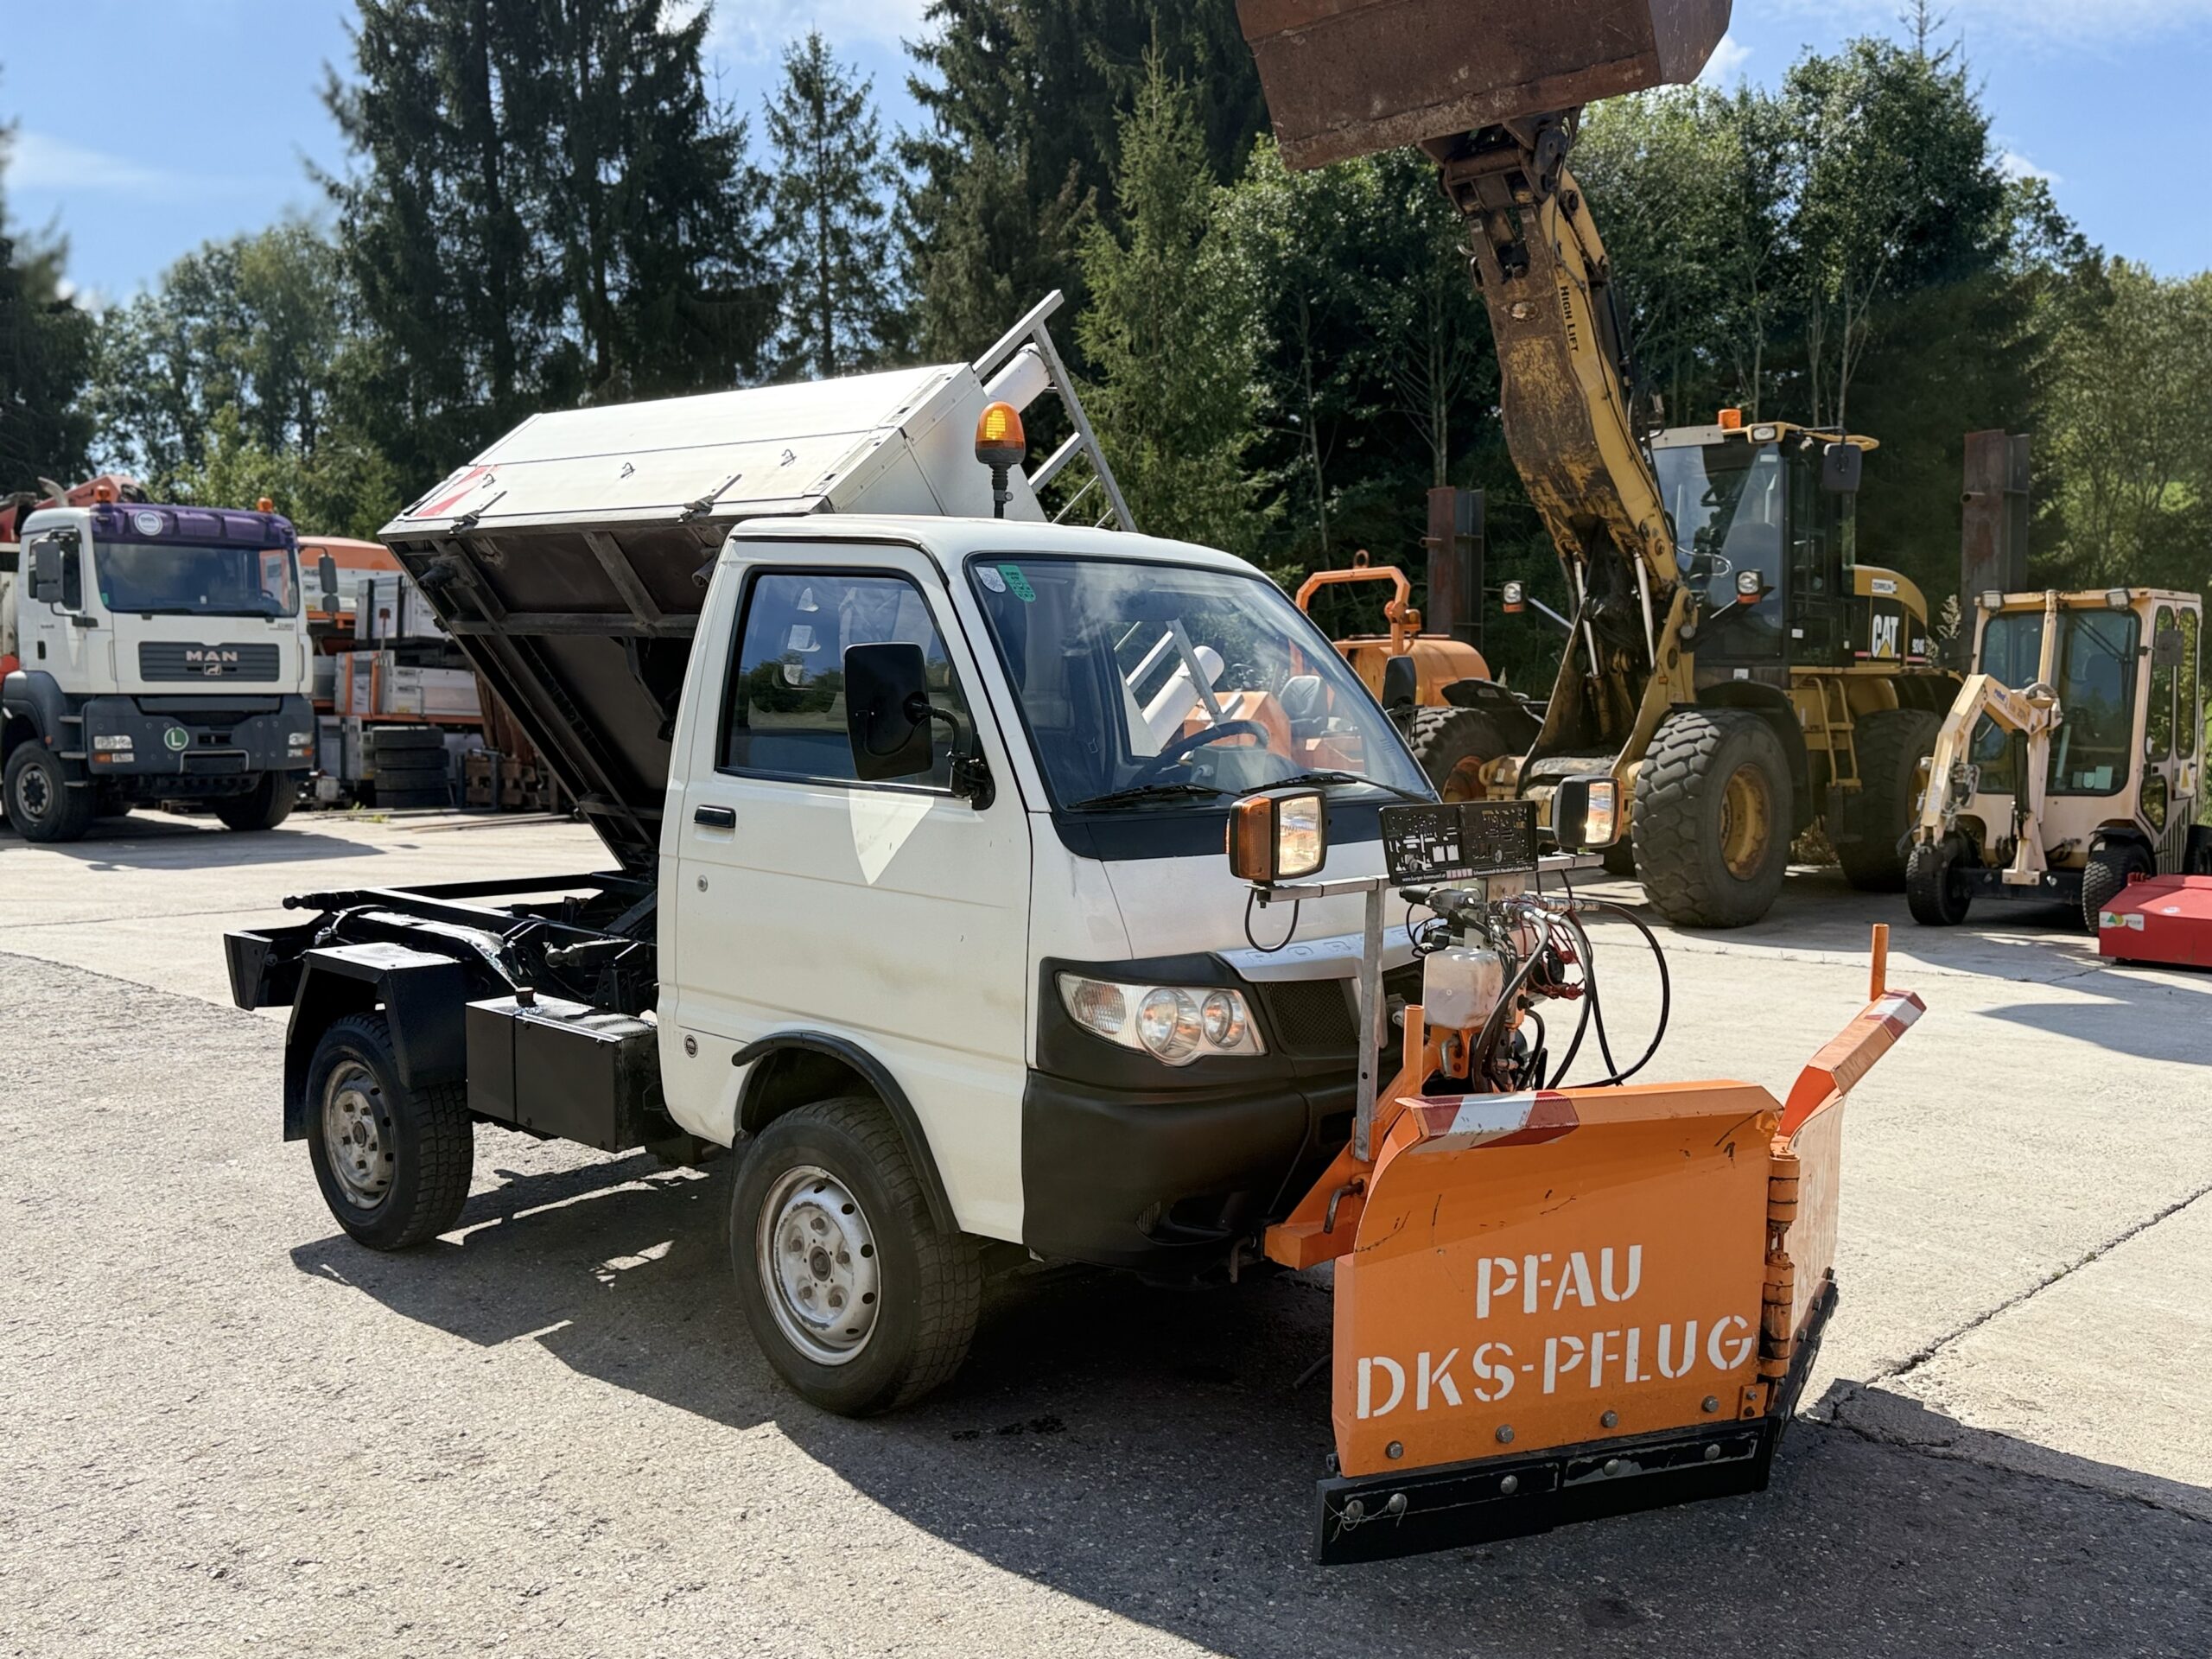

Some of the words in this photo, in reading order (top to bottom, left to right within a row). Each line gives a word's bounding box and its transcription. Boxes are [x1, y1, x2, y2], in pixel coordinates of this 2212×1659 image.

[1560, 285, 1573, 320] HIGH
[1567, 323, 1580, 353] LIFT
[186, 650, 238, 662] MAN
[1872, 614, 1899, 658] CAT
[171, 732, 181, 747] L
[1476, 1244, 1643, 1319] PFAU
[1357, 1315, 1752, 1420] DKS-PFLUG
